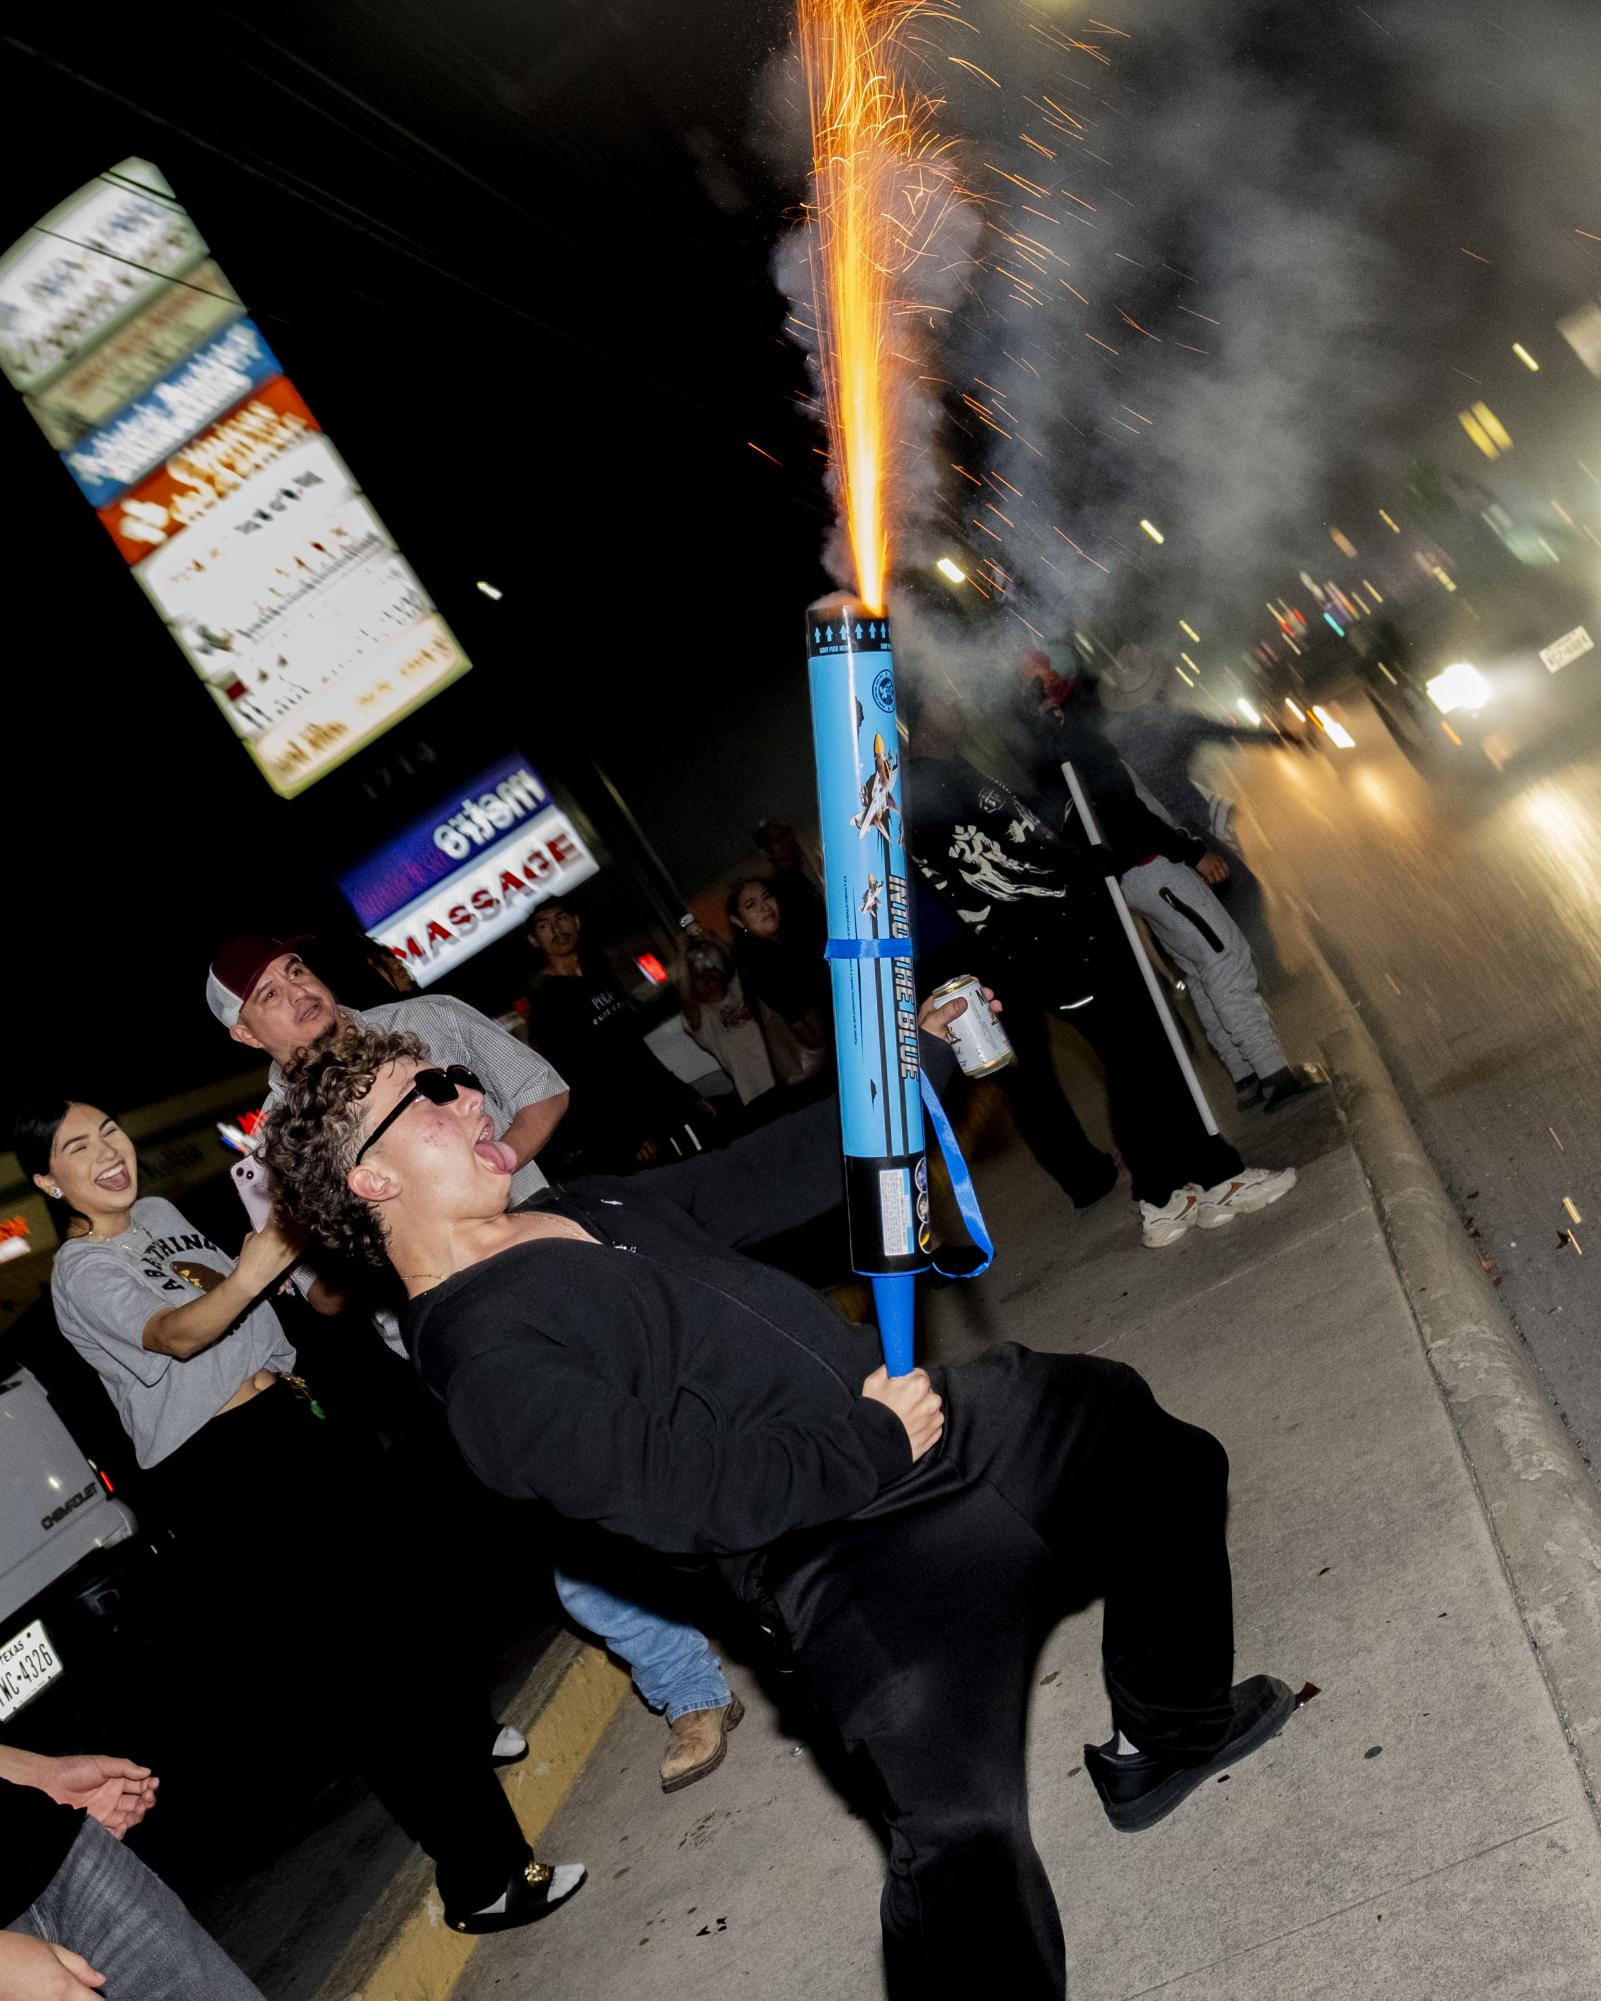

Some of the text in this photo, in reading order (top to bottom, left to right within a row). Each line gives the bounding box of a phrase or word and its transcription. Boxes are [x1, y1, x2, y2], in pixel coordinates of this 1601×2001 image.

[386, 832, 586, 967] MASSAGE
[897, 1010, 920, 1080] BLUE
[162, 1279, 185, 1290] A
[41, 1482, 98, 1531] CHEVROLET
